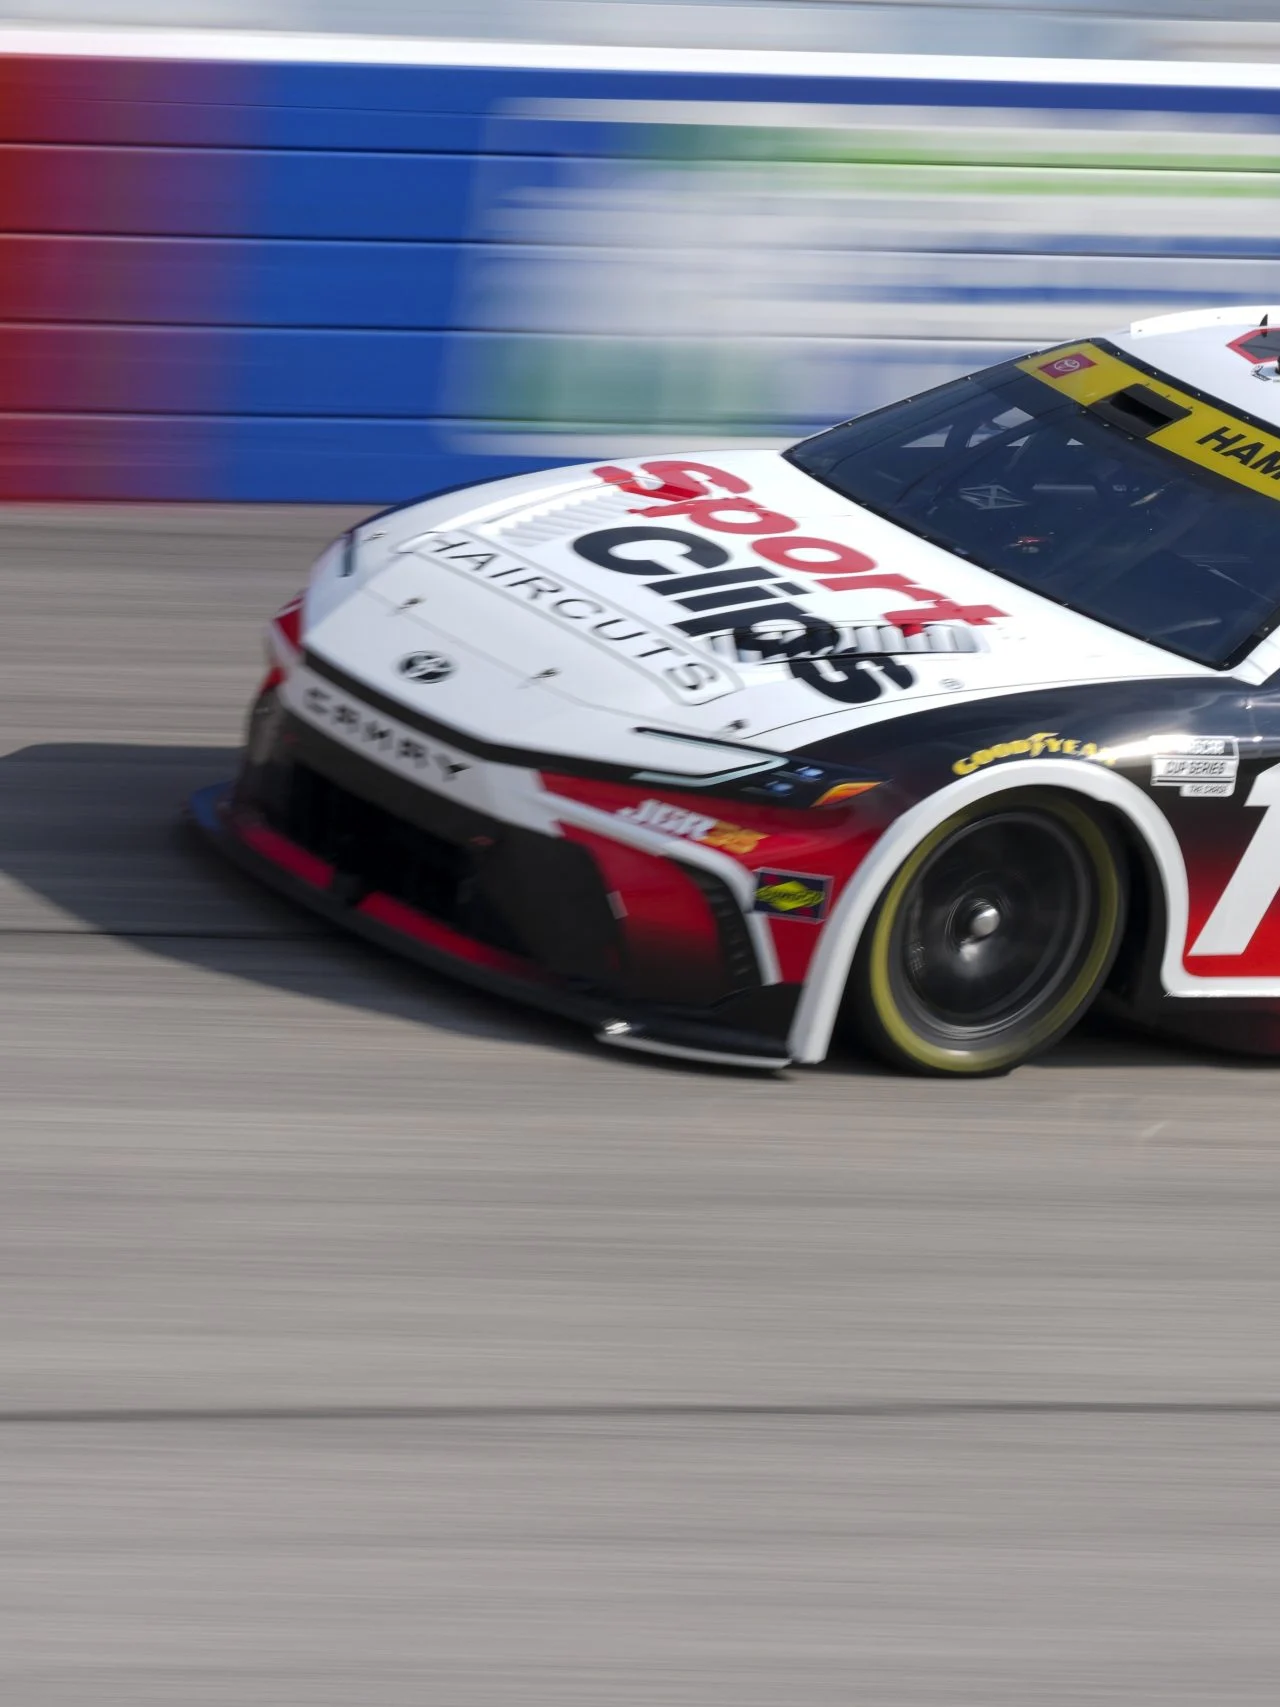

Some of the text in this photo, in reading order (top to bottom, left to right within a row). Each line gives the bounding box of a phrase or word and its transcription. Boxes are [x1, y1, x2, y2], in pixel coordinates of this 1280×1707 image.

[415, 533, 719, 694] HAIRCUTS
[572, 525, 920, 704] Clips
[593, 460, 1010, 638] Sport
[303, 686, 472, 783] CAMRY
[1166, 761, 1226, 775] CUP SERIES
